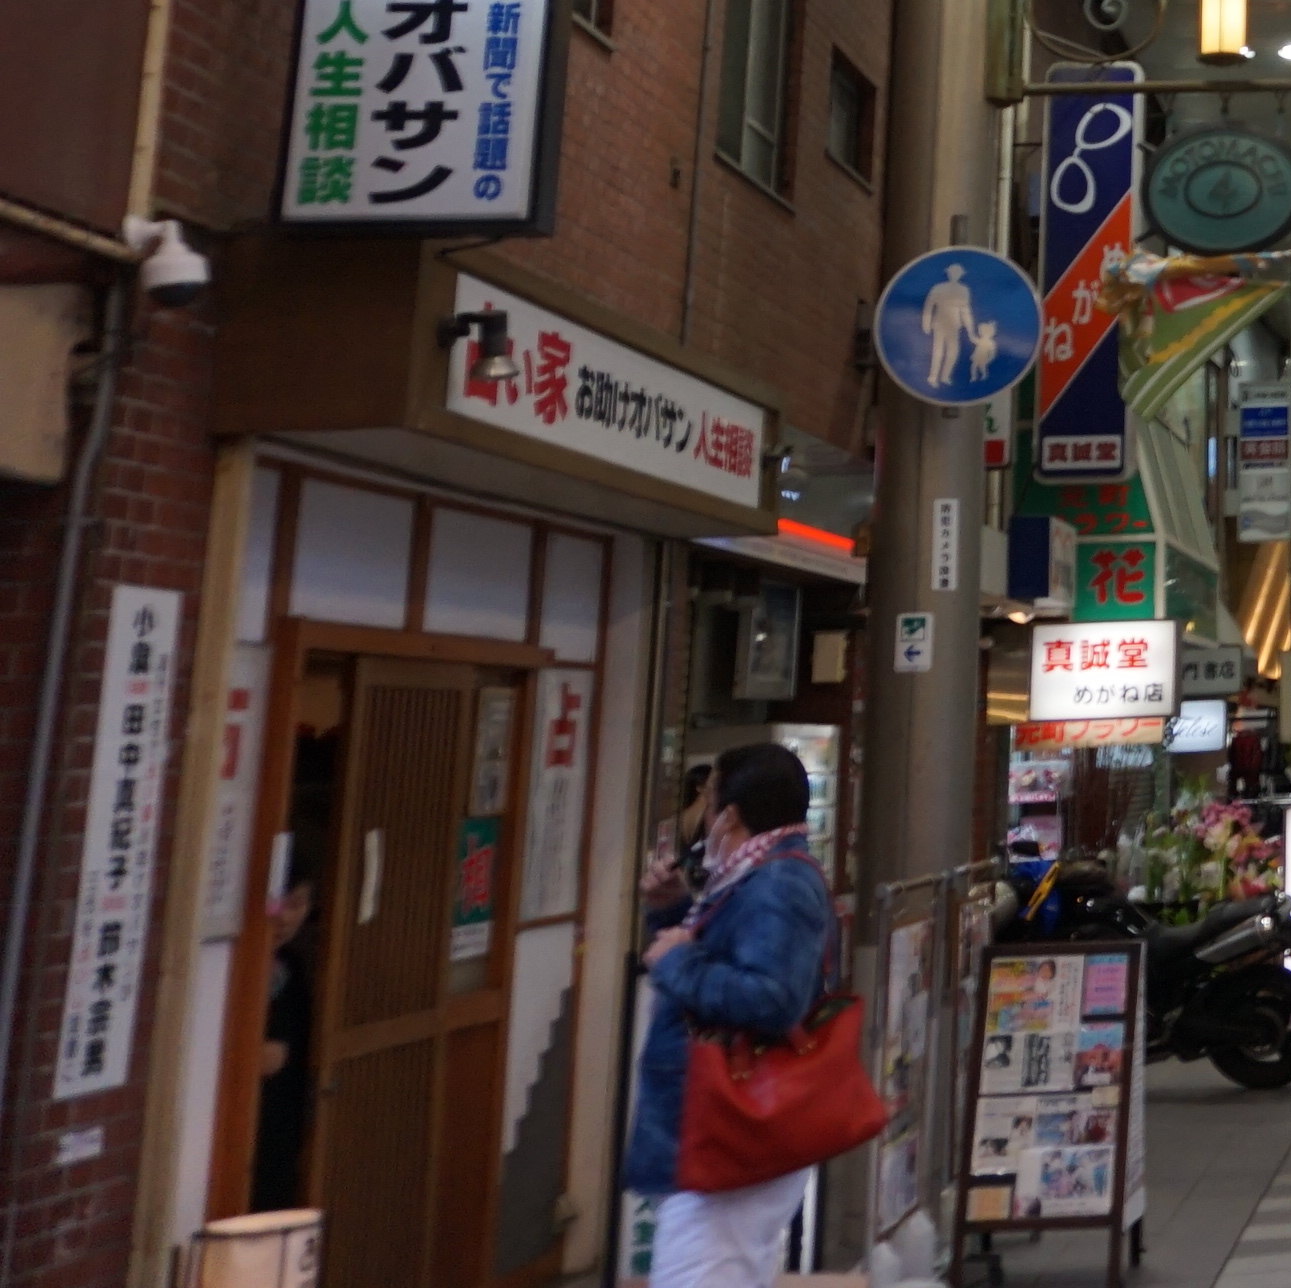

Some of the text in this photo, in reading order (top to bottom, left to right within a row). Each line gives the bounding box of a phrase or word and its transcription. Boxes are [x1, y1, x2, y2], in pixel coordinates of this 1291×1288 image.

[297, 0, 370, 205] 人生相談
[575, 365, 693, 453] お助けオバサン
[1090, 548, 1145, 604] 花
[1042, 638, 1149, 672] 真誠堂
[1073, 682, 1164, 703] めがね店
